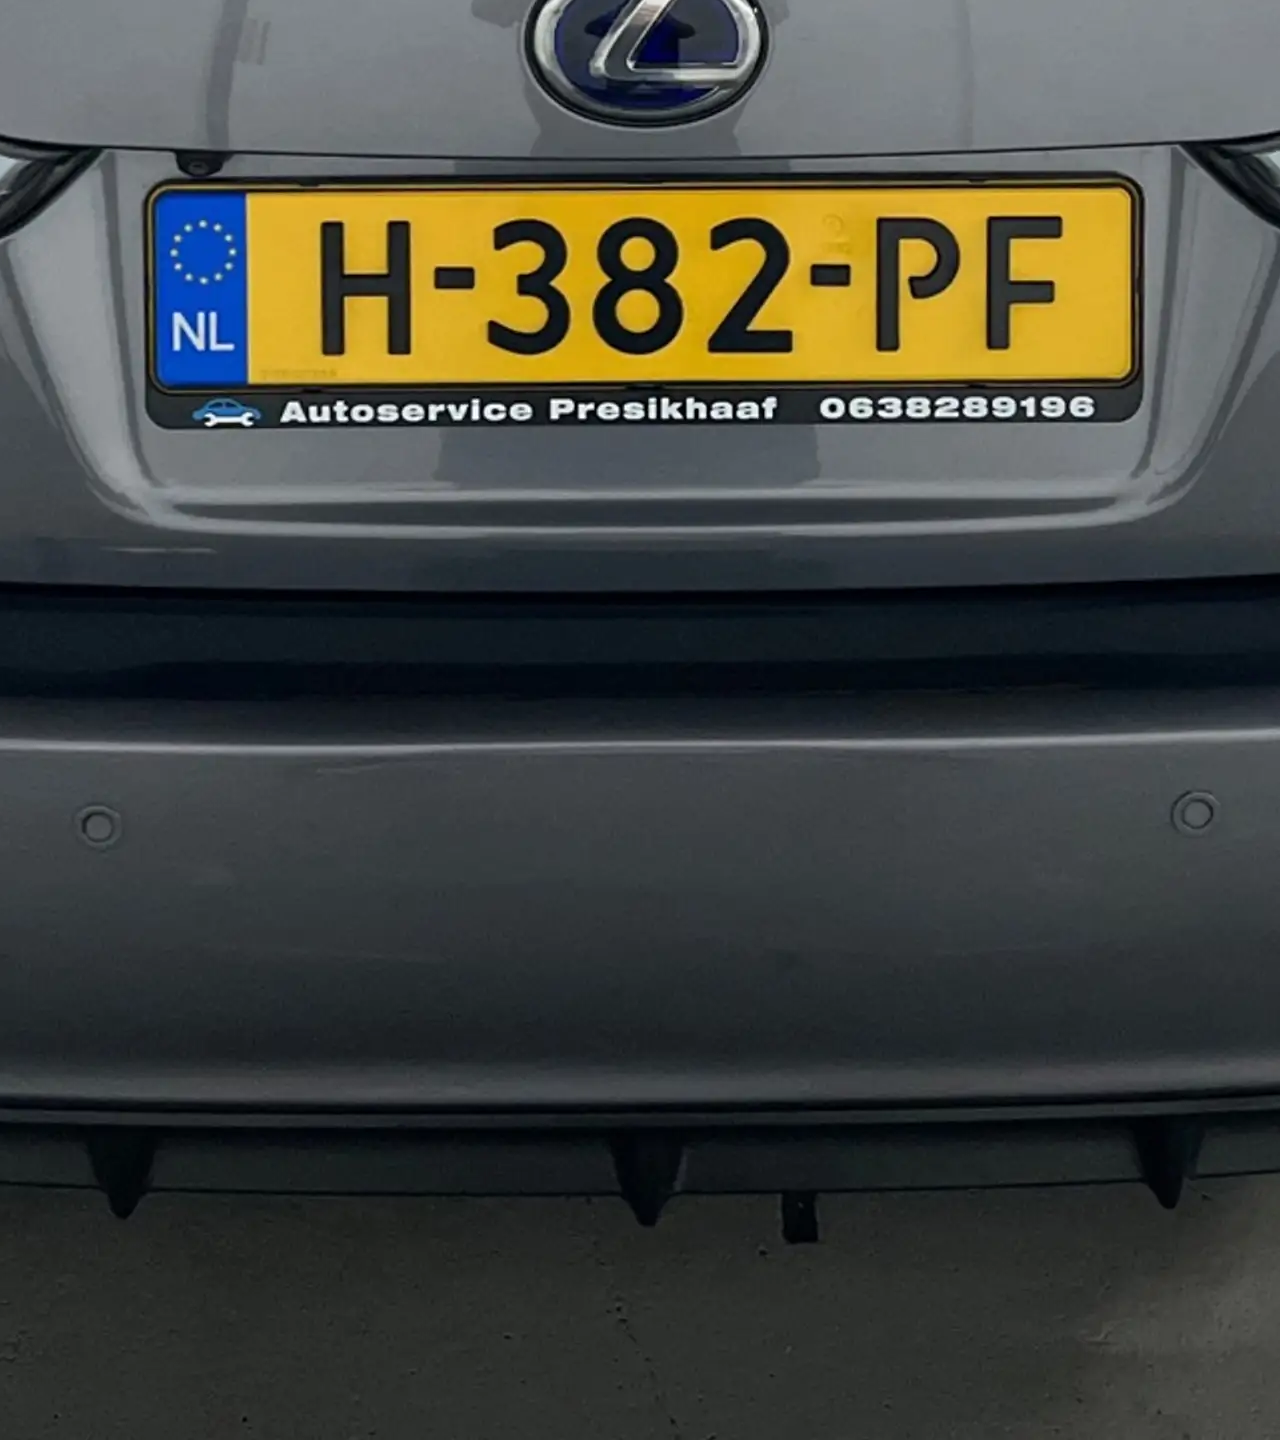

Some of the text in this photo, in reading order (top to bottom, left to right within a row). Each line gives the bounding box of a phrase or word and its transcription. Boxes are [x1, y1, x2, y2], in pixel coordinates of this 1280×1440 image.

[319, 215, 1064, 356] H-382-PF
[171, 311, 235, 352] NL
[279, 395, 1096, 424] Autoservice Presikhaaf 0638289196
